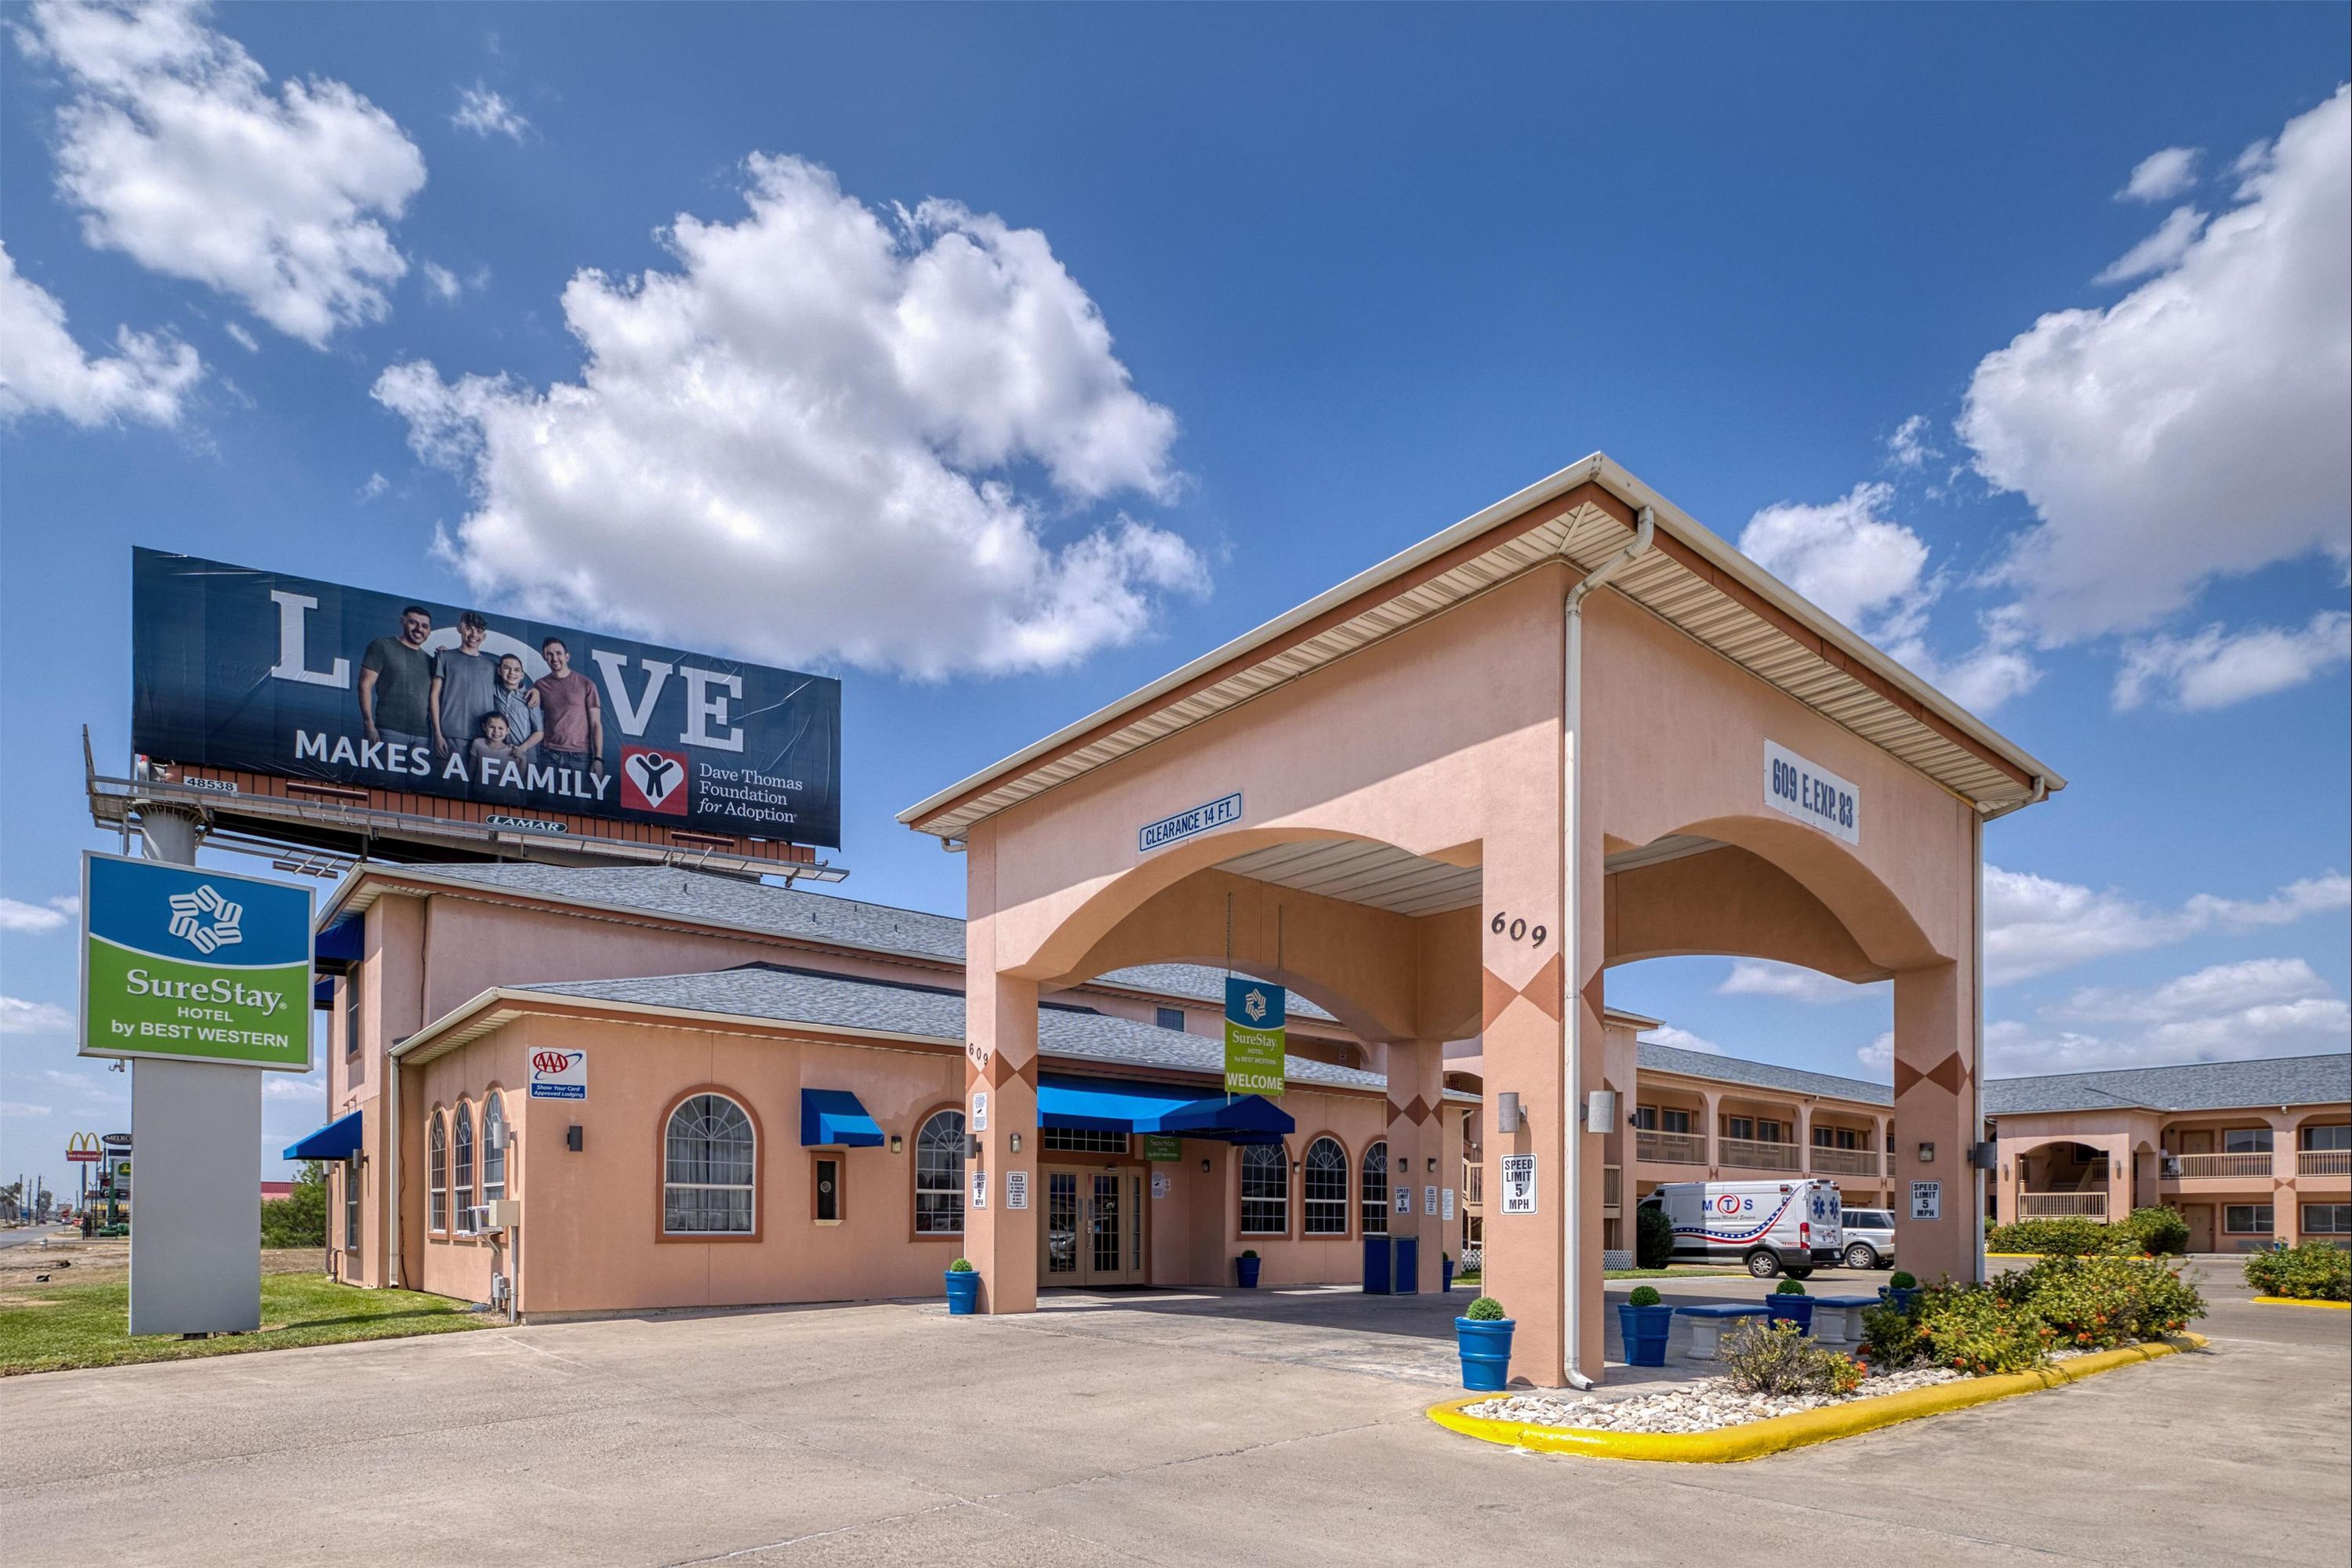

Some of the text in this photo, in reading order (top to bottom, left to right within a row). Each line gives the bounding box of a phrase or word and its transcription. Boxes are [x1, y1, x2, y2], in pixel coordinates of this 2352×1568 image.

[295, 729, 612, 800] MAKES A FAMILY
[187, 778, 234, 791] 48538
[699, 763, 803, 790] Dave Thomas
[699, 780, 788, 805] Foundation
[1773, 758, 1797, 802] 609
[1838, 792, 1853, 829] 83
[697, 798, 795, 823] for Adoption
[492, 815, 559, 831] LAMAR
[1145, 801, 1232, 845] CLEARANCE 14 FT.
[1491, 911, 1547, 949] 609
[177, 1007, 234, 1022] HOTEL
[111, 1019, 289, 1048] by BEST WESTERN
[1232, 1030, 1277, 1051] SureStay
[535, 1051, 566, 1073] AAA
[969, 1043, 988, 1066] 609
[1226, 1072, 1283, 1091] WELCOME
[1504, 1159, 1533, 1170] SPEED
[1506, 1171, 1531, 1182] LIMIT
[1515, 1183, 1523, 1197] 5
[1509, 1199, 1529, 1210] MPH
[1922, 1200, 1929, 1209] 5
